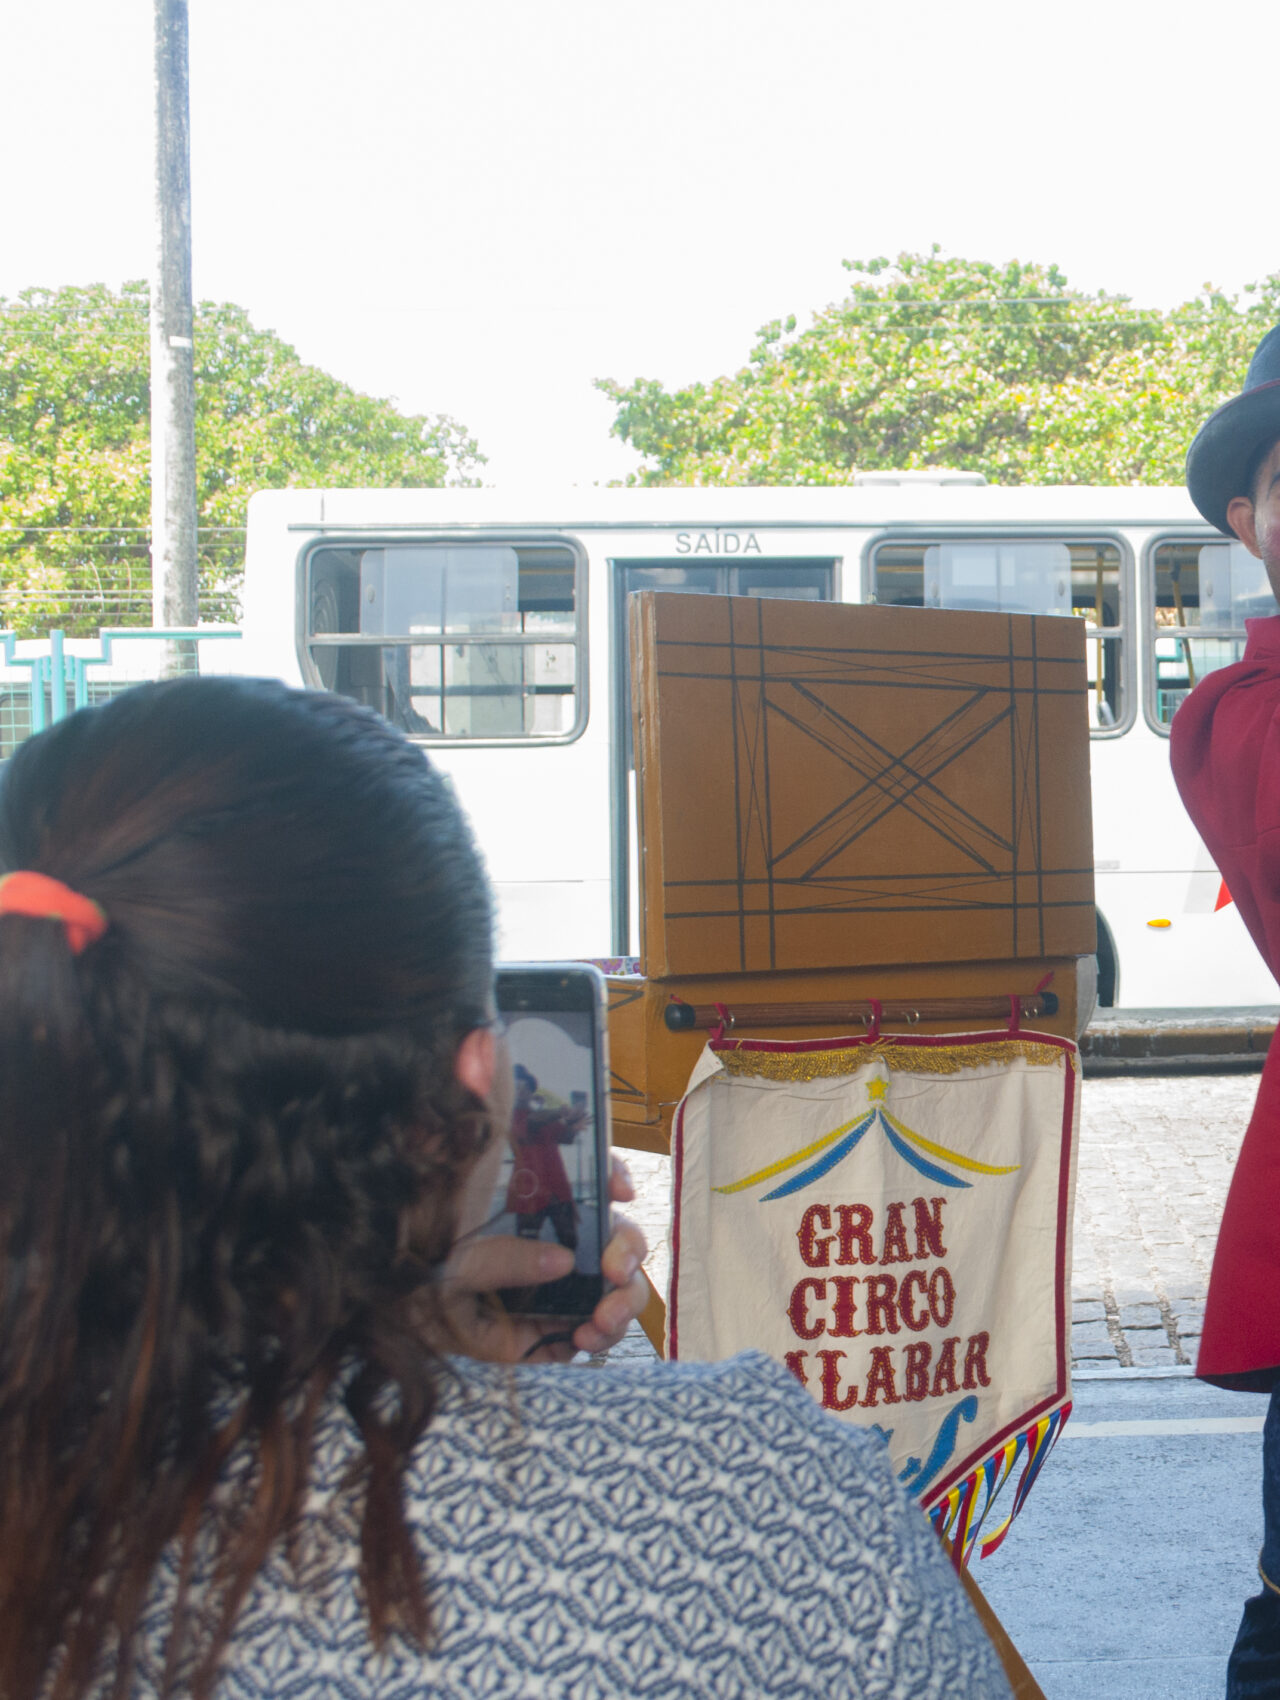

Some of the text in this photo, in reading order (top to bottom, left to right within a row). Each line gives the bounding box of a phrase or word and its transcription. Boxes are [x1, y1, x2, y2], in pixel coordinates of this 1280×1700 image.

[676, 529, 762, 554] SAÍDA
[796, 1197, 948, 1268] GRAN
[786, 1266, 957, 1340] CIRCO
